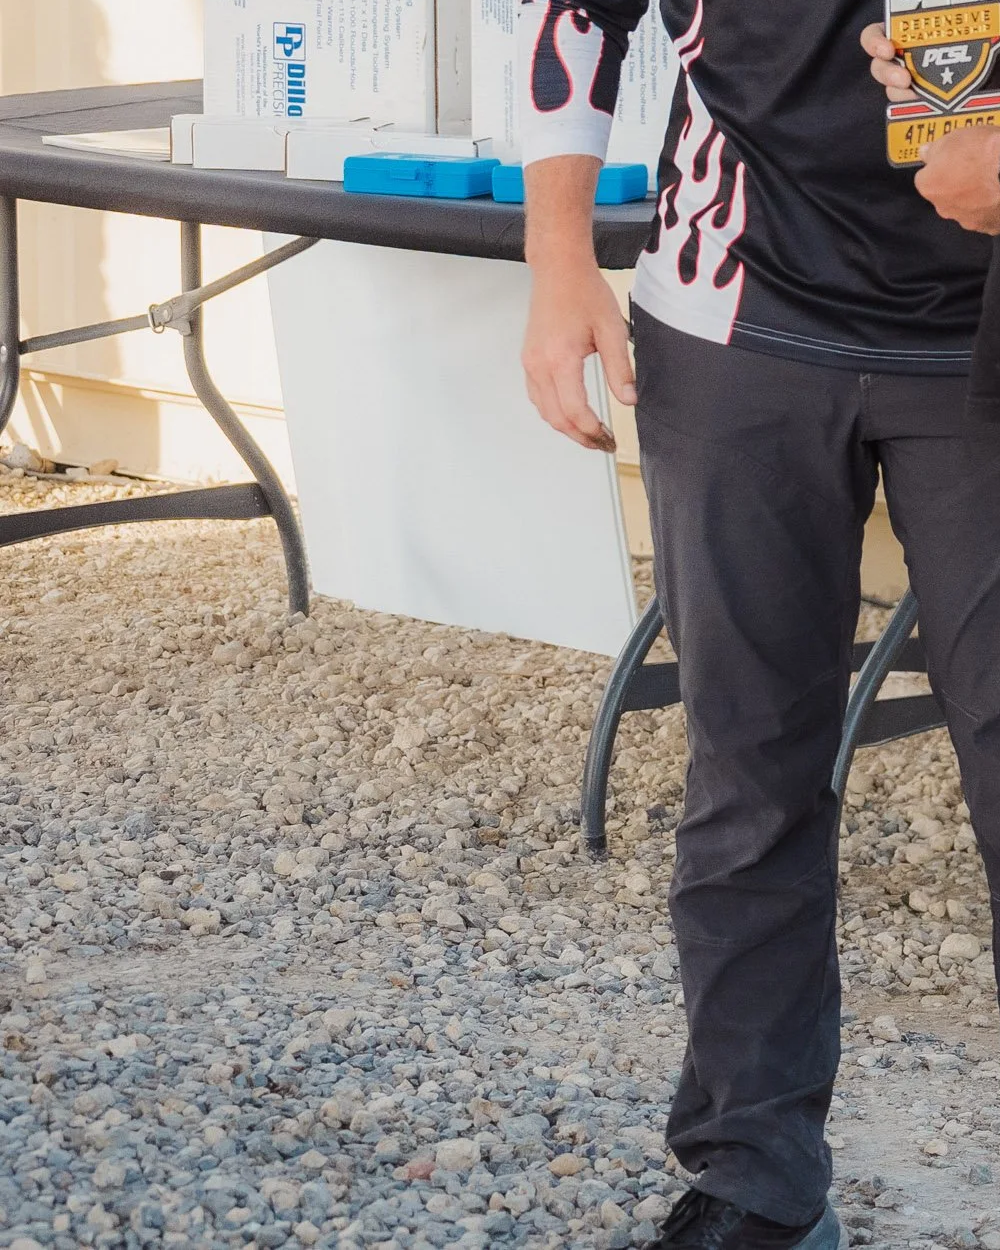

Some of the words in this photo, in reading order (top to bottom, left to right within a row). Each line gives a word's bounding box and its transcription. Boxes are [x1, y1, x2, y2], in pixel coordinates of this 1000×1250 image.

[900, 9, 991, 31] DEFENSIVE
[922, 44, 973, 68] PCSL
[273, 62, 284, 117] PRECISI
[904, 122, 936, 144] 4TH
